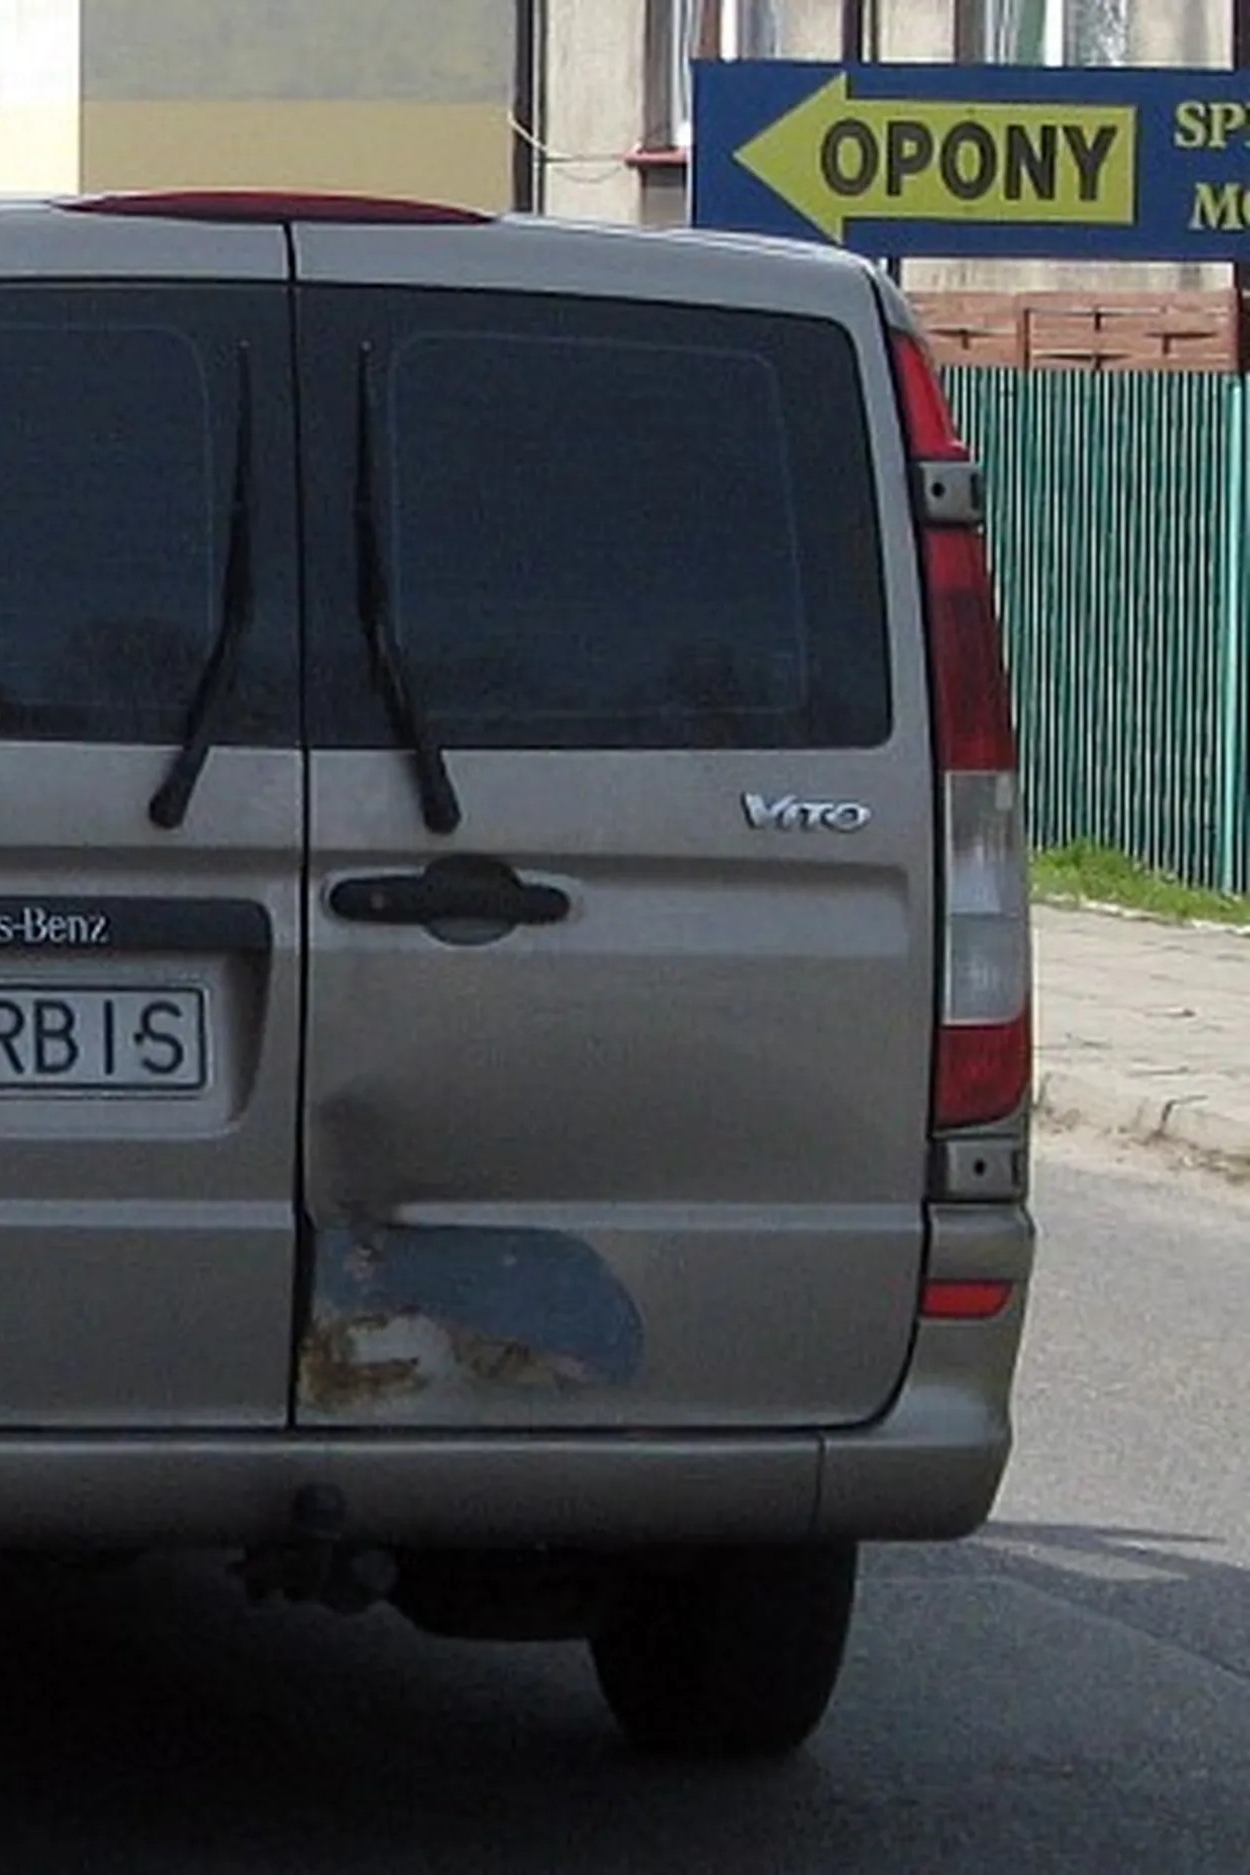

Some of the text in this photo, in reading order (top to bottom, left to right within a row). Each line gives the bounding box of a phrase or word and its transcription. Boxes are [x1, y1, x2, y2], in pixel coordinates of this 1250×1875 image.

[1174, 100, 1250, 149] SP
[819, 117, 1118, 202] OPONY
[1187, 181, 1250, 231] M
